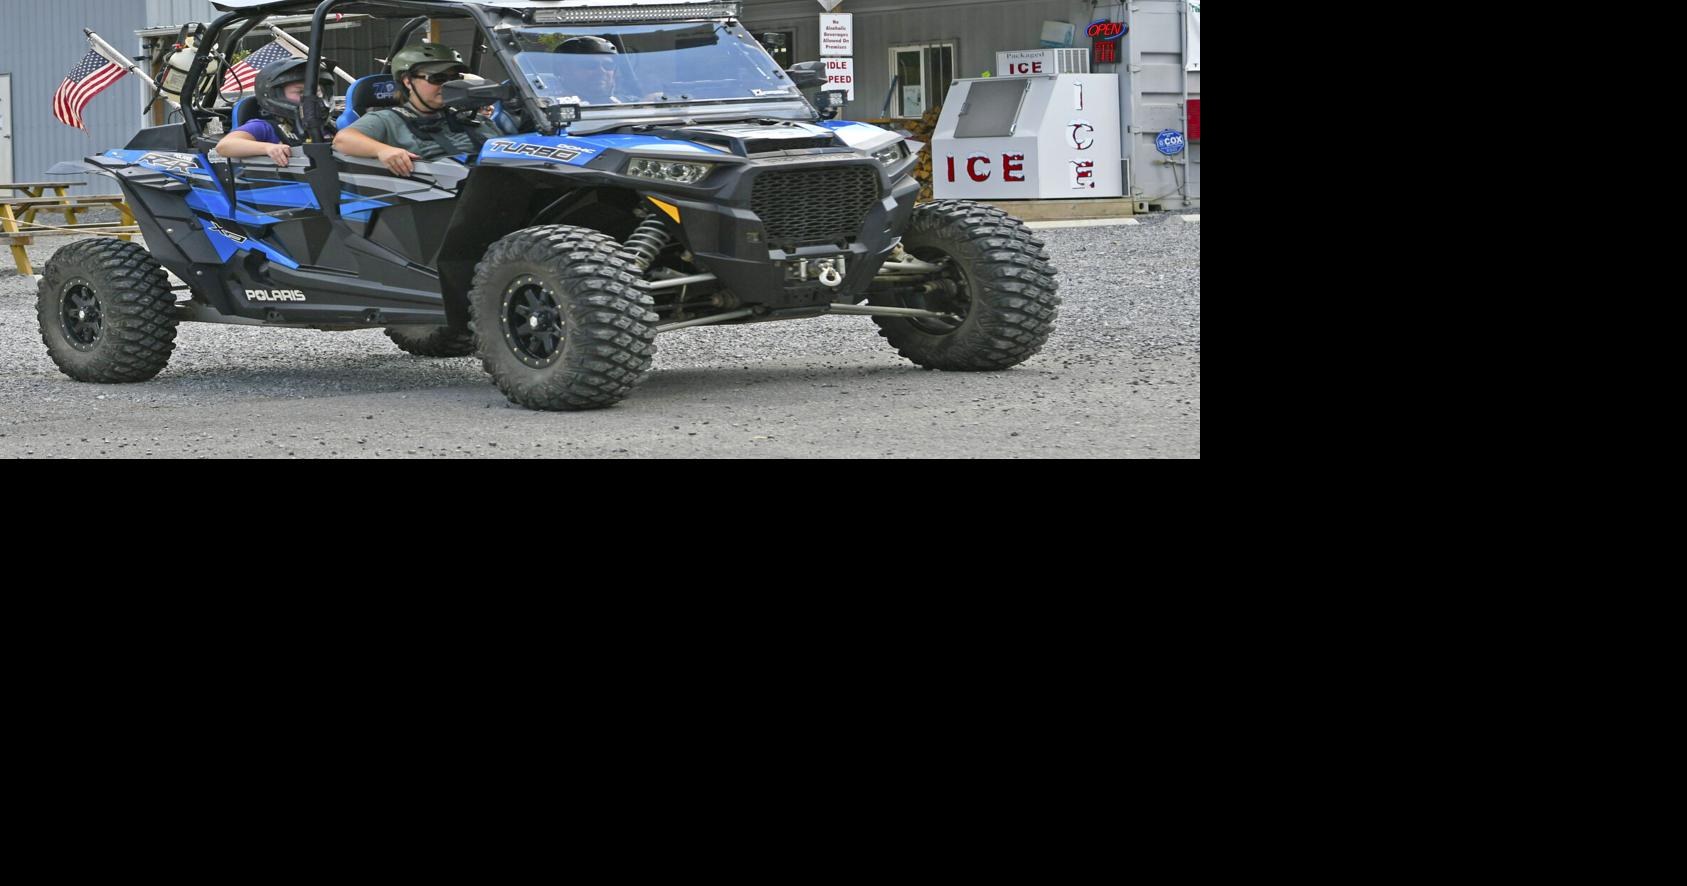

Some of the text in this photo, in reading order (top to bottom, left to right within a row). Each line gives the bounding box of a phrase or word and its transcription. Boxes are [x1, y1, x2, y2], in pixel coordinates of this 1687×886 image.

[1088, 23, 1121, 37] OPEN
[1006, 51, 1045, 60] Packaged
[826, 61, 847, 69] IDLE
[1009, 61, 1043, 75] ICE
[828, 75, 852, 83] PEED
[1164, 135, 1182, 145] COX
[490, 141, 581, 162] TURBO
[137, 152, 198, 175] RZR
[946, 151, 1026, 183] ICE
[208, 220, 248, 244] XP
[245, 289, 306, 301] POLARIS
